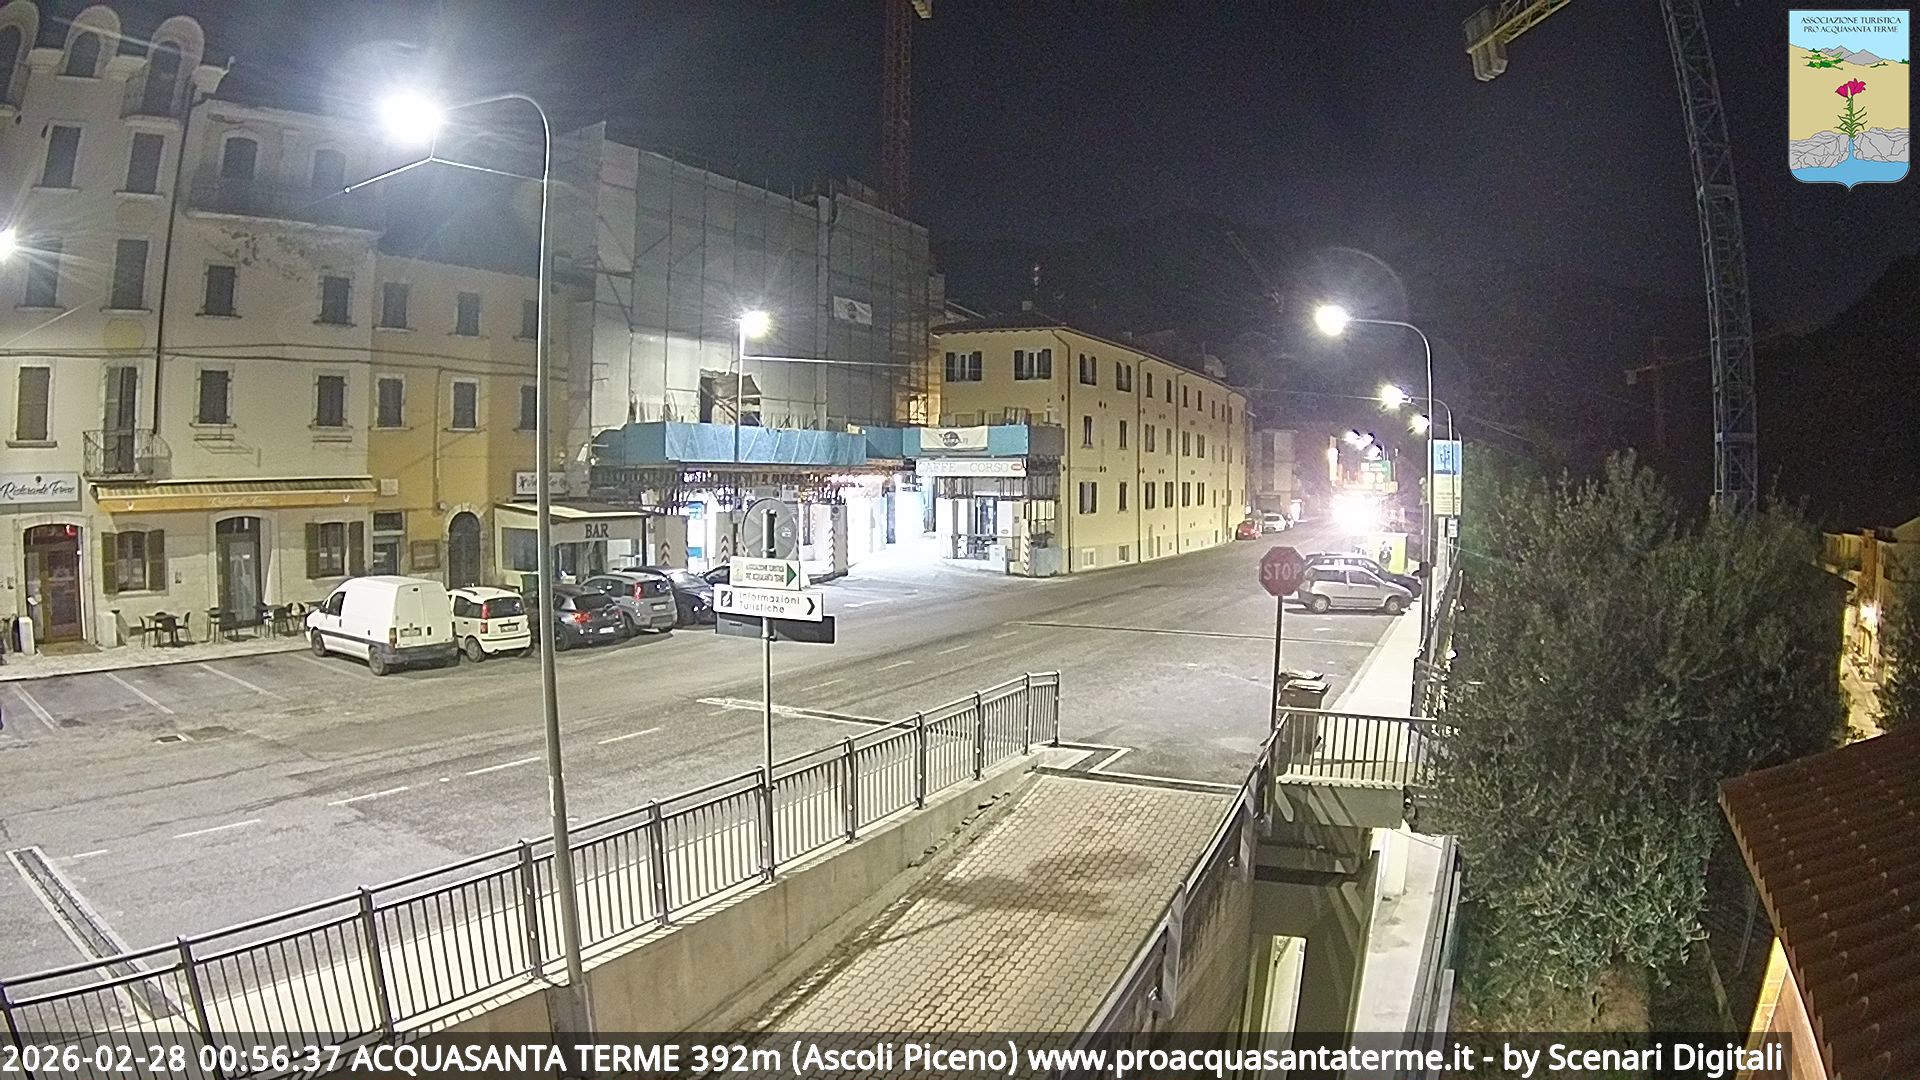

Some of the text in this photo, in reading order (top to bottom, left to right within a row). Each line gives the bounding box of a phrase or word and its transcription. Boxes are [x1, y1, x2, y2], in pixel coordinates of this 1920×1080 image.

[969, 462, 1009, 473] CORSO
[584, 522, 609, 539] BAR
[1263, 562, 1302, 581] STOP
[739, 592, 800, 605] Informazioni
[739, 600, 785, 614] Turistiche
